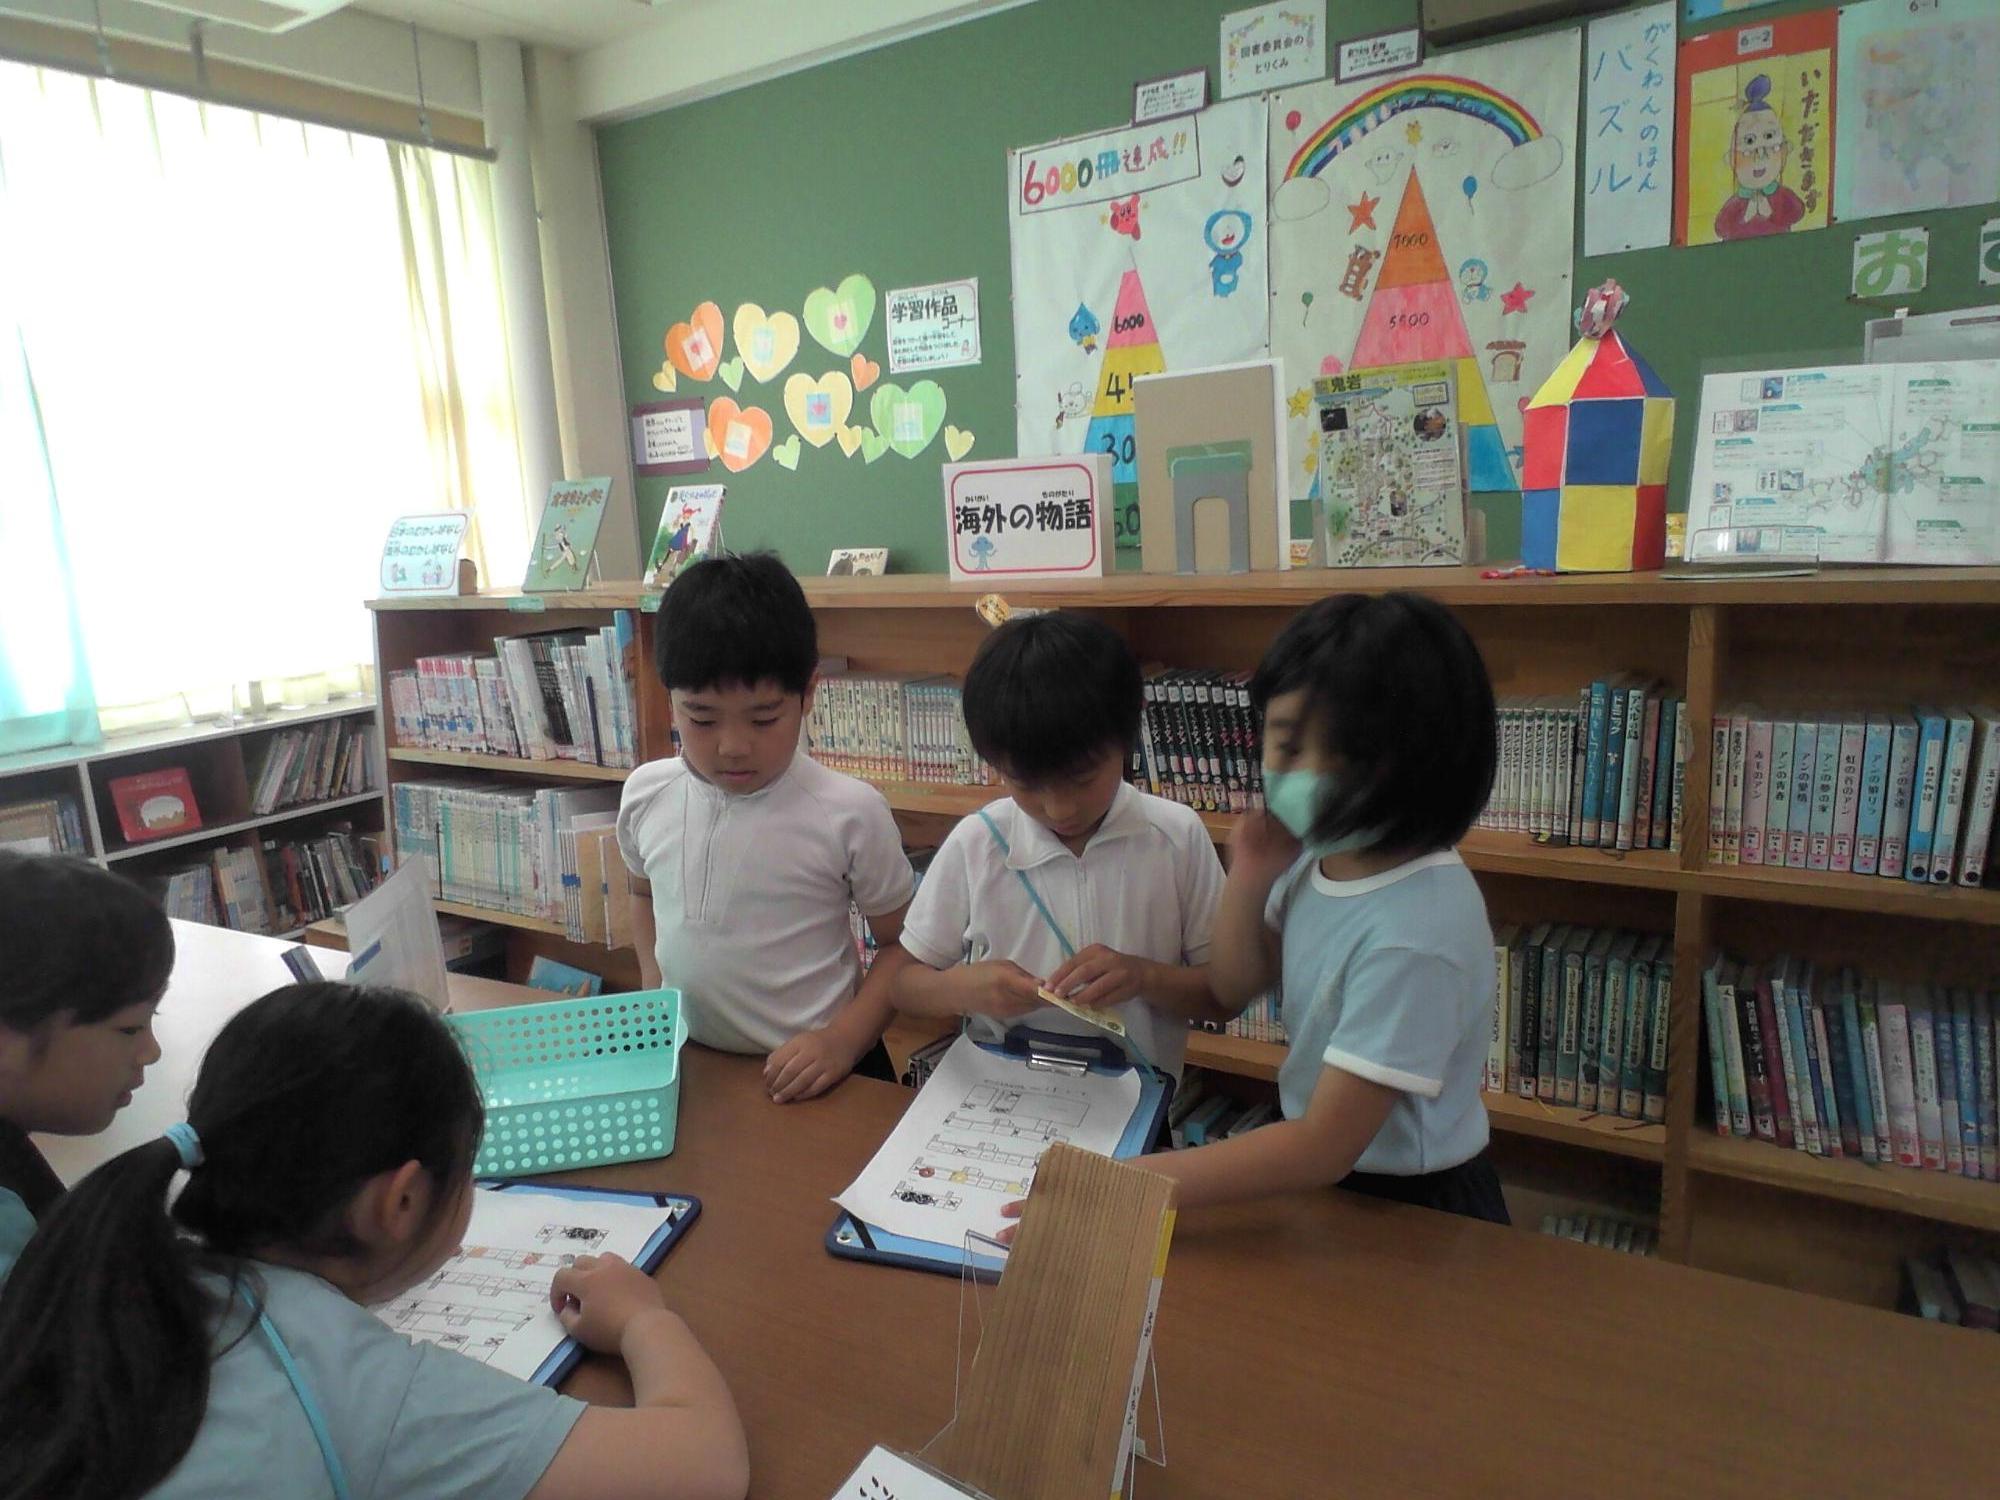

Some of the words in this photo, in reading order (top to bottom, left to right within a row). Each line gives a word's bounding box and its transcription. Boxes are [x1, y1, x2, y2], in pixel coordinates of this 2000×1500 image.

[1255, 57, 1289, 74] とりくみ
[1798, 68, 1822, 213] いただきます
[1855, 233, 1928, 296] お
[892, 295, 958, 324] 学習作品
[1114, 313, 1144, 334] 6000
[955, 498, 1092, 535] 海外の物語
